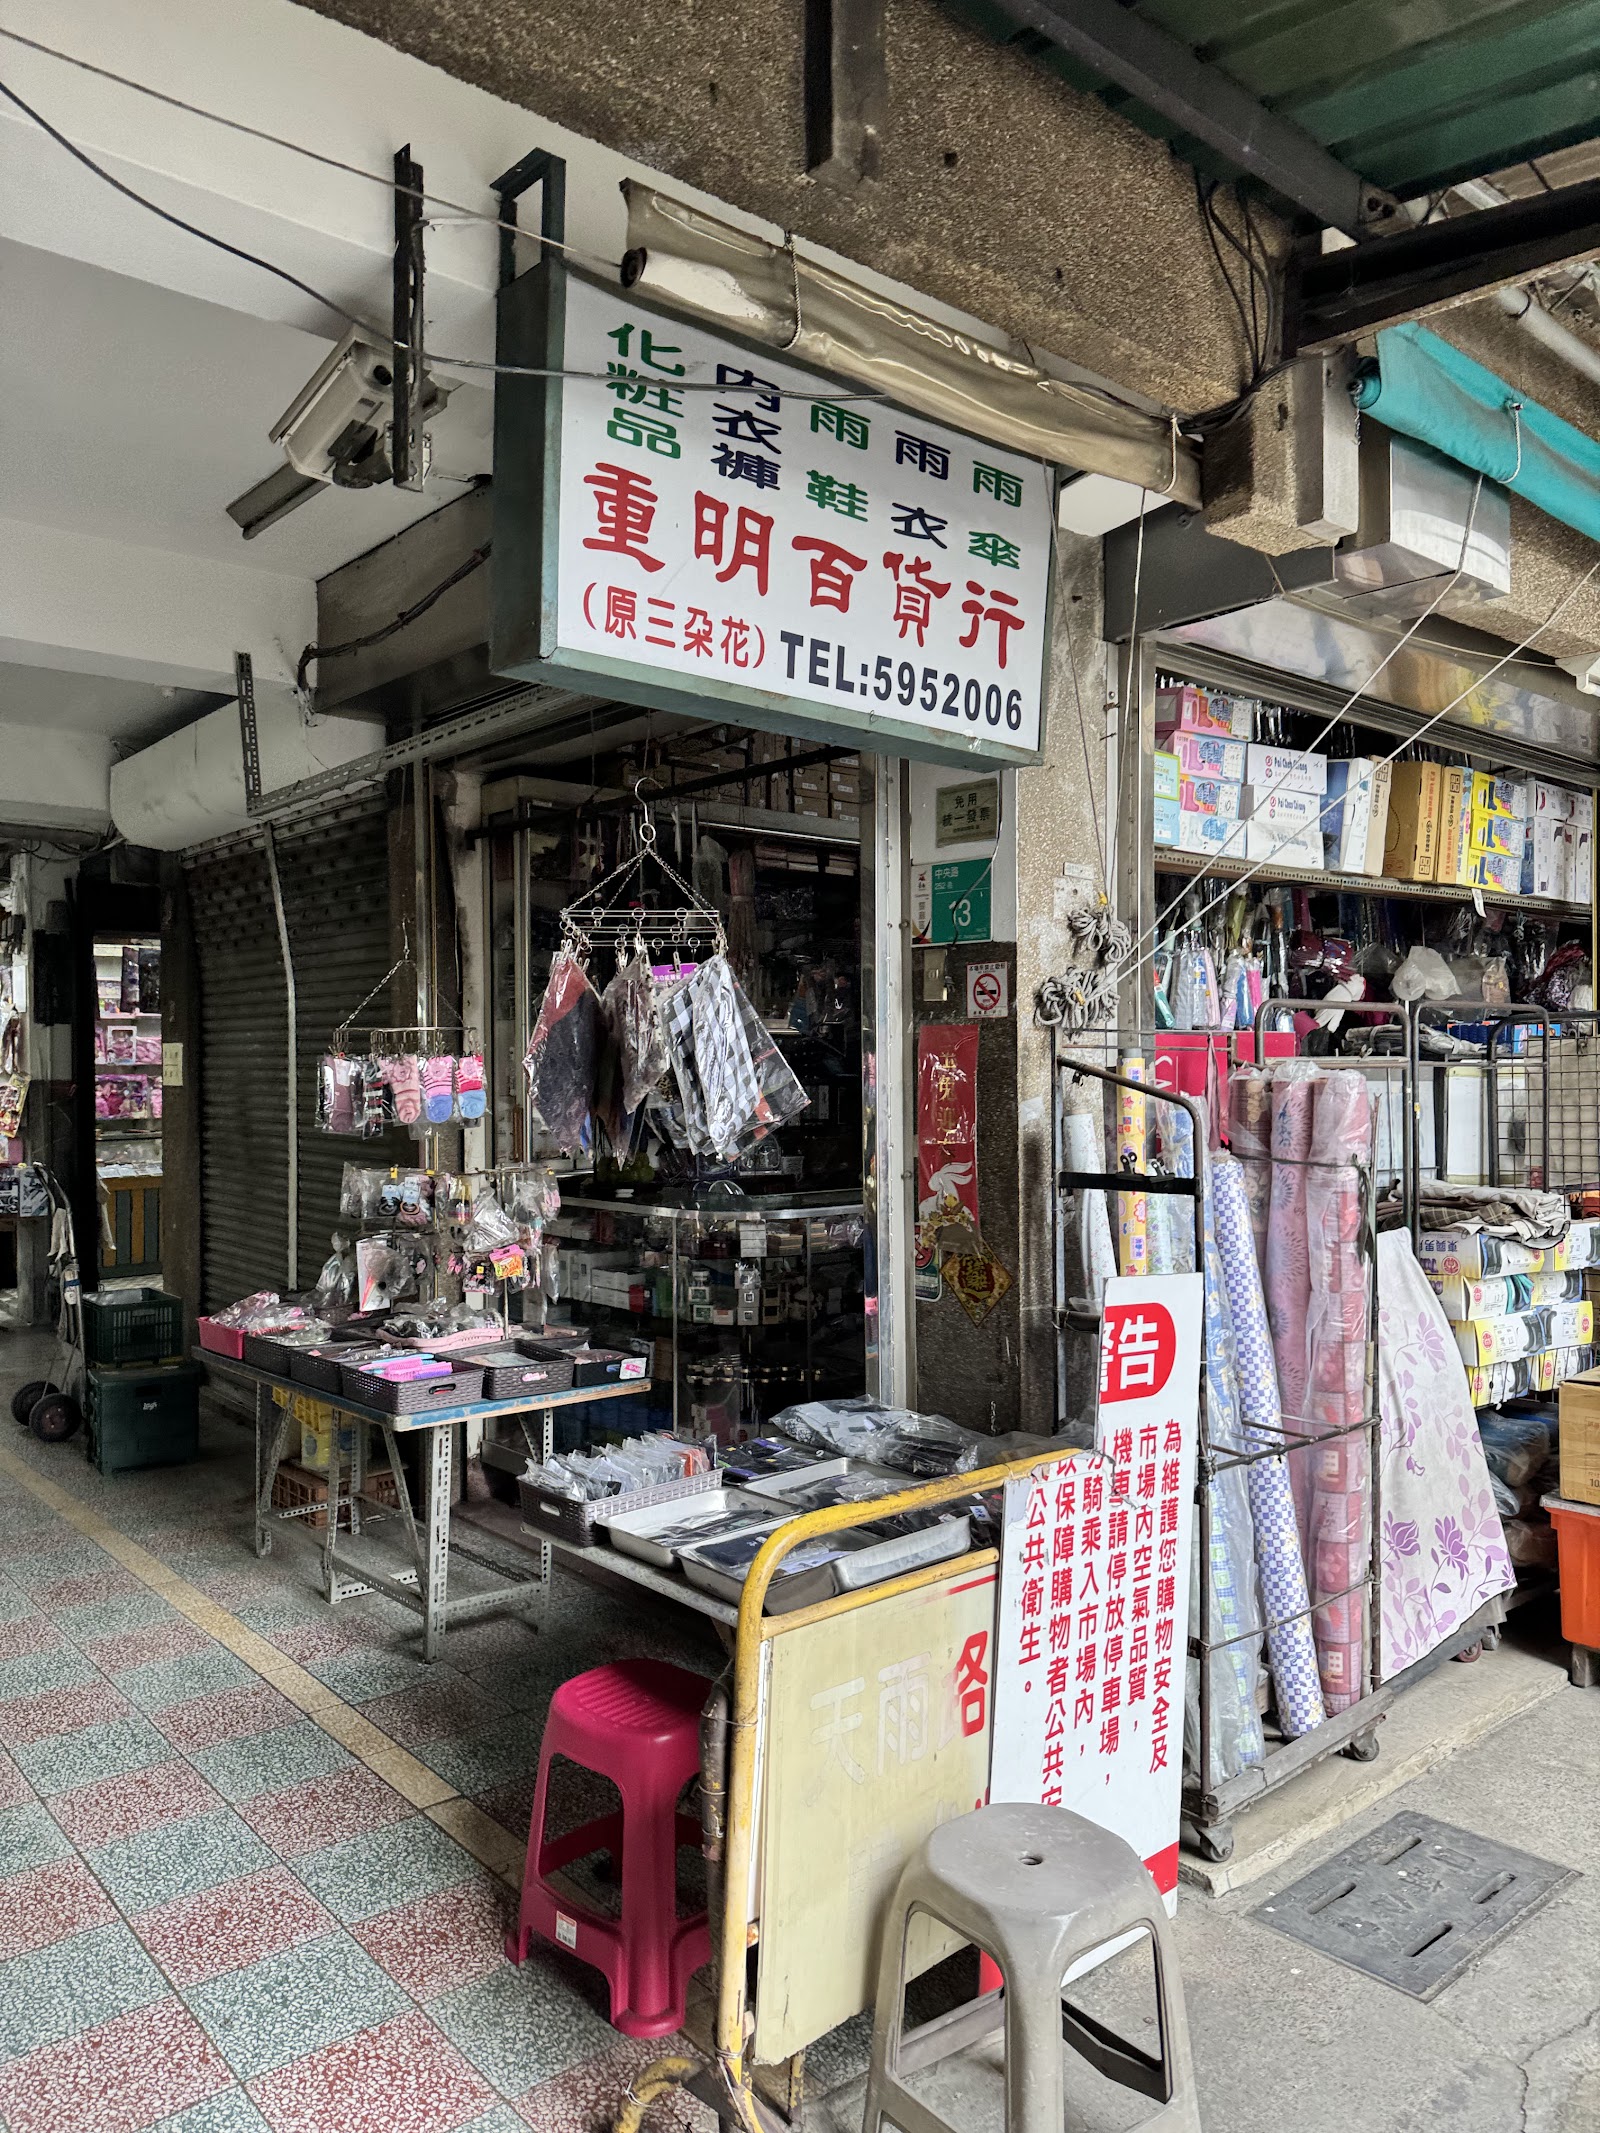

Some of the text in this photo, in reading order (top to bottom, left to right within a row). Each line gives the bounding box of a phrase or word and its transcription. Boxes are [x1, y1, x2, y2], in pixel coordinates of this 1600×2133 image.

[806, 399, 872, 523] 雨鞋
[890, 429, 950, 550] 雨衣
[967, 459, 1024, 571] 雨傘
[581, 461, 1026, 671] 重明百貨行
[953, 792, 978, 809] 免用
[948, 899, 972, 927] 13
[1018, 1466, 1050, 1693] 公共衛生。
[1149, 1418, 1182, 1775] 為維護您購物安全及
